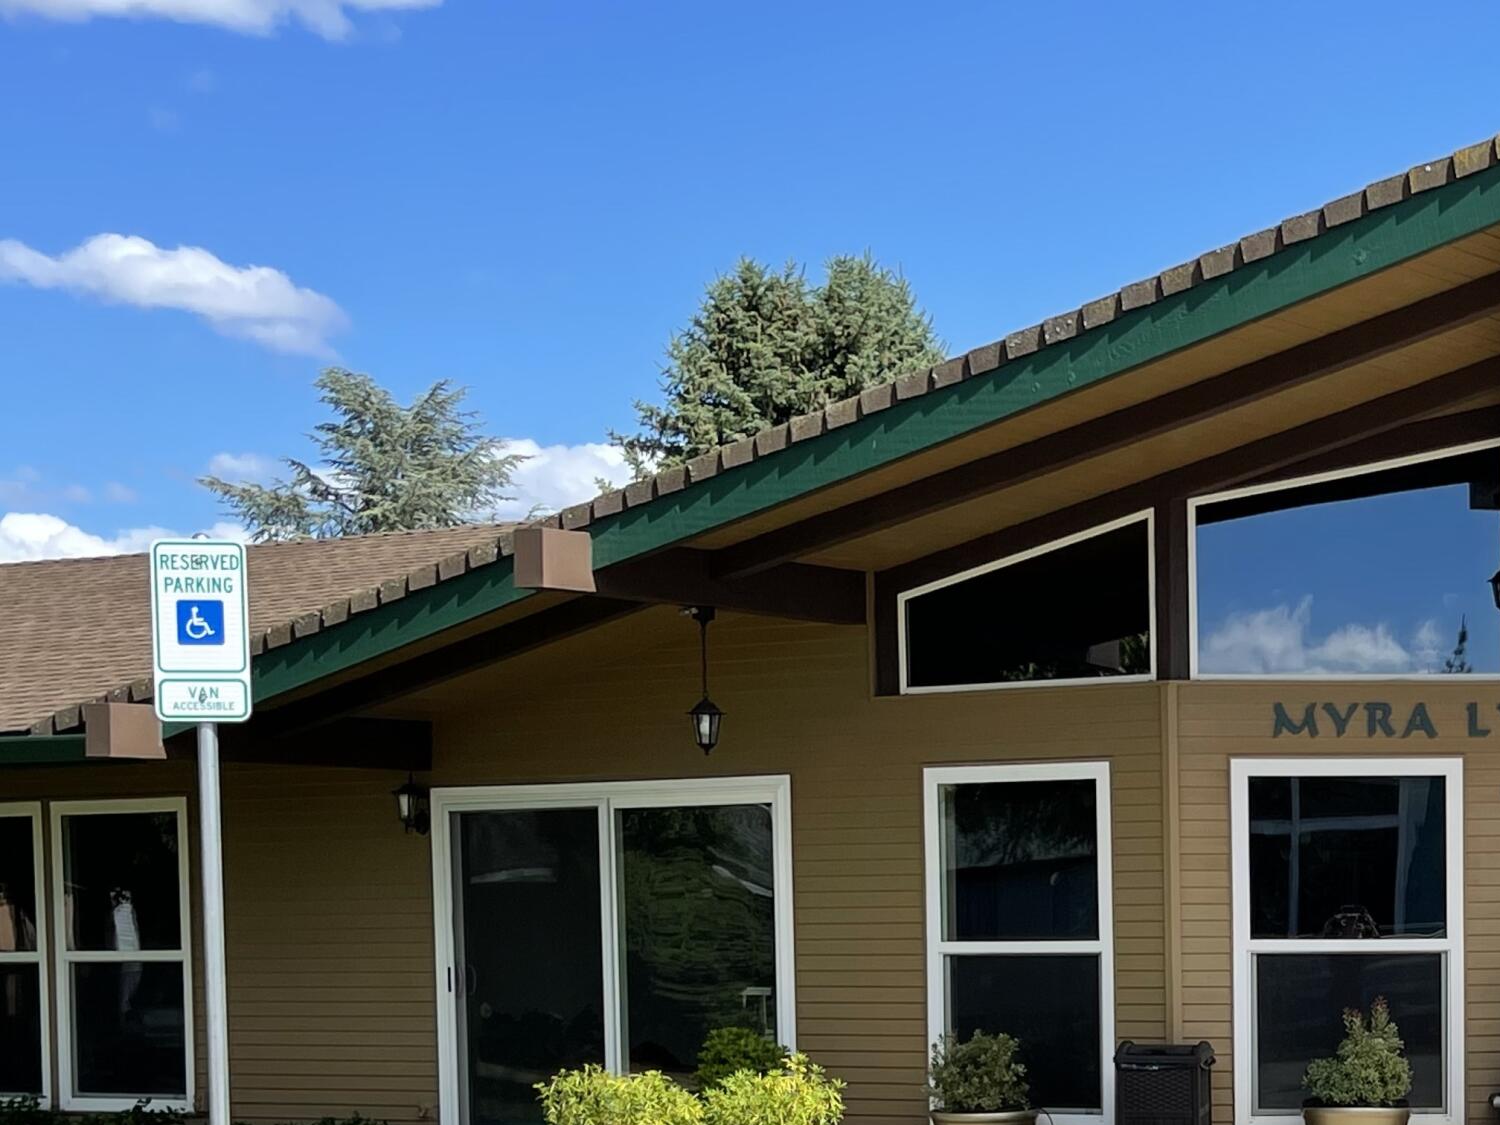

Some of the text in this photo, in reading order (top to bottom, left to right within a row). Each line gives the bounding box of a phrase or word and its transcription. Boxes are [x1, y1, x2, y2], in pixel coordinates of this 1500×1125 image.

[160, 554, 239, 570] RESERVED
[164, 577, 233, 593] PARKING
[188, 687, 219, 699] VAN
[173, 702, 235, 711] ACCESSIBLE
[1272, 702, 1439, 738] MYRA
